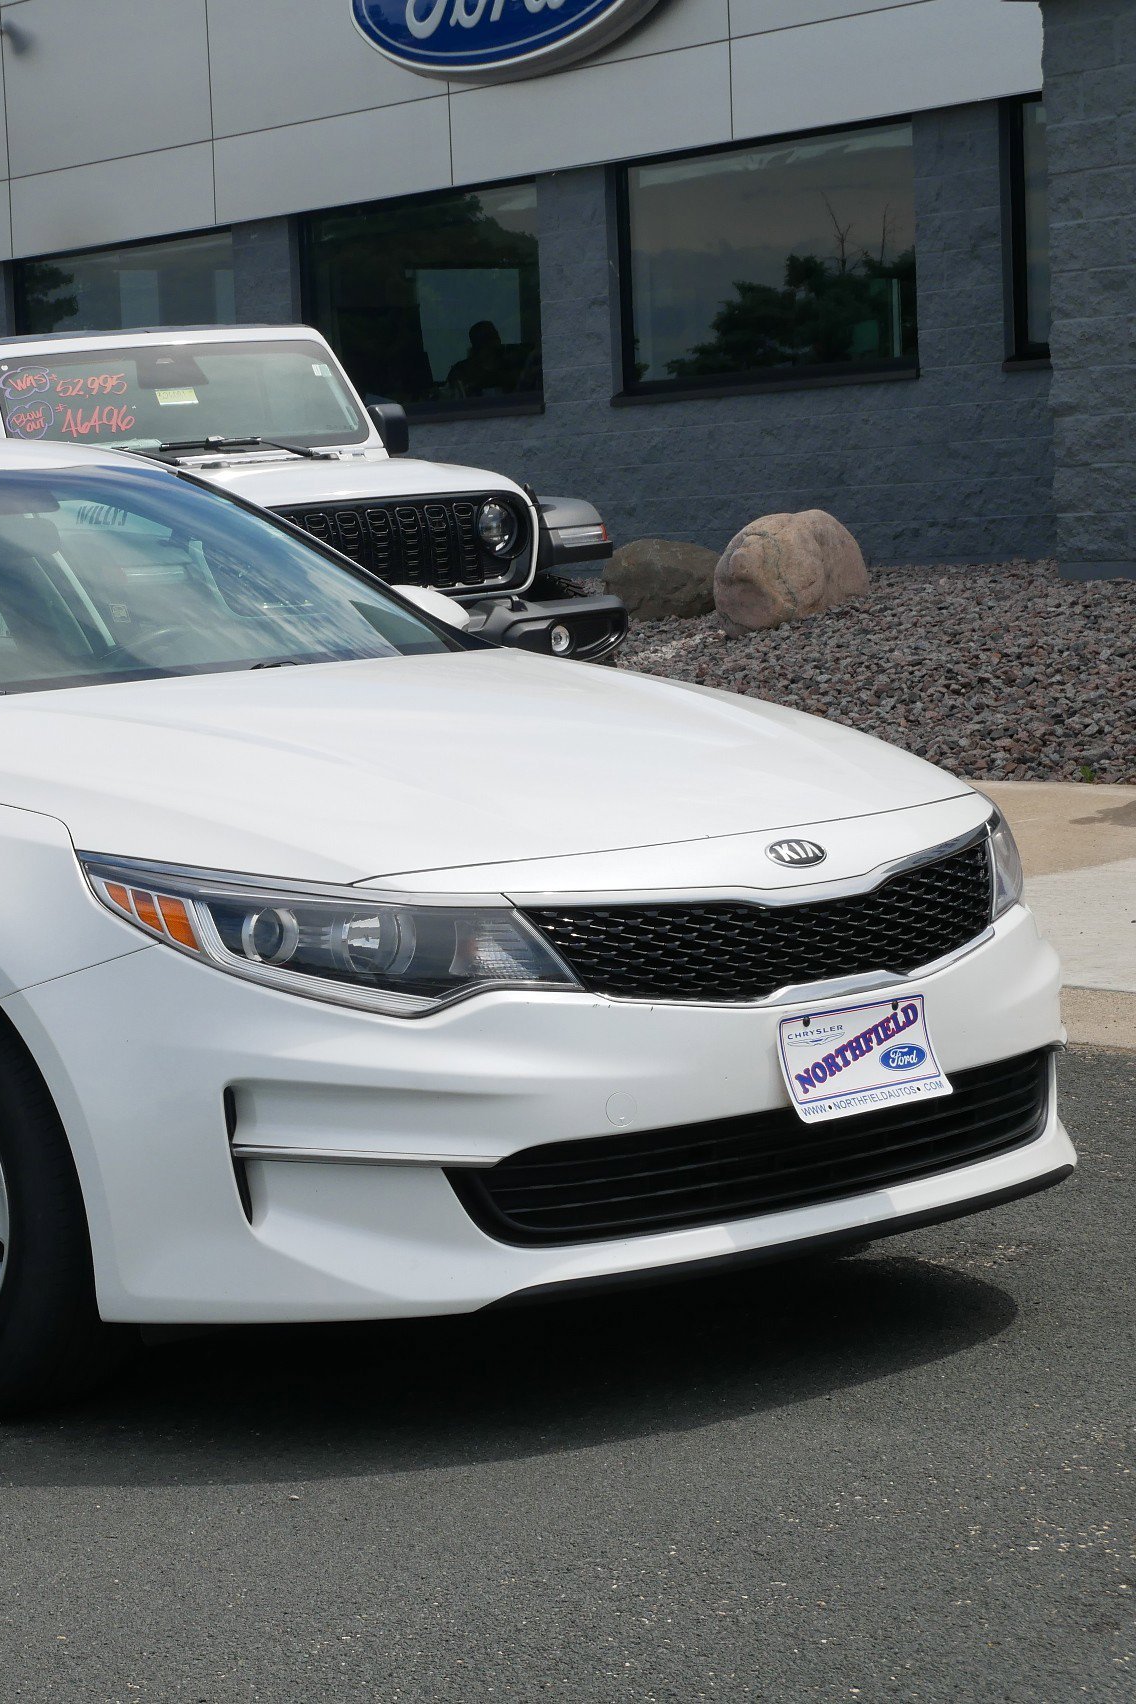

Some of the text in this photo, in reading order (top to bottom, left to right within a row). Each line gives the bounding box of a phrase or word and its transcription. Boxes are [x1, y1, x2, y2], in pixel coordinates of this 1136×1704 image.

[8, 373, 47, 392] WAS
[10, 405, 46, 428] BLOW
[26, 416, 46, 433] OUT
[772, 841, 823, 861] KIA
[787, 1024, 844, 1040] CHRYSLER
[794, 1002, 919, 1095] NORTHFIELD
[889, 1047, 918, 1068] Ford
